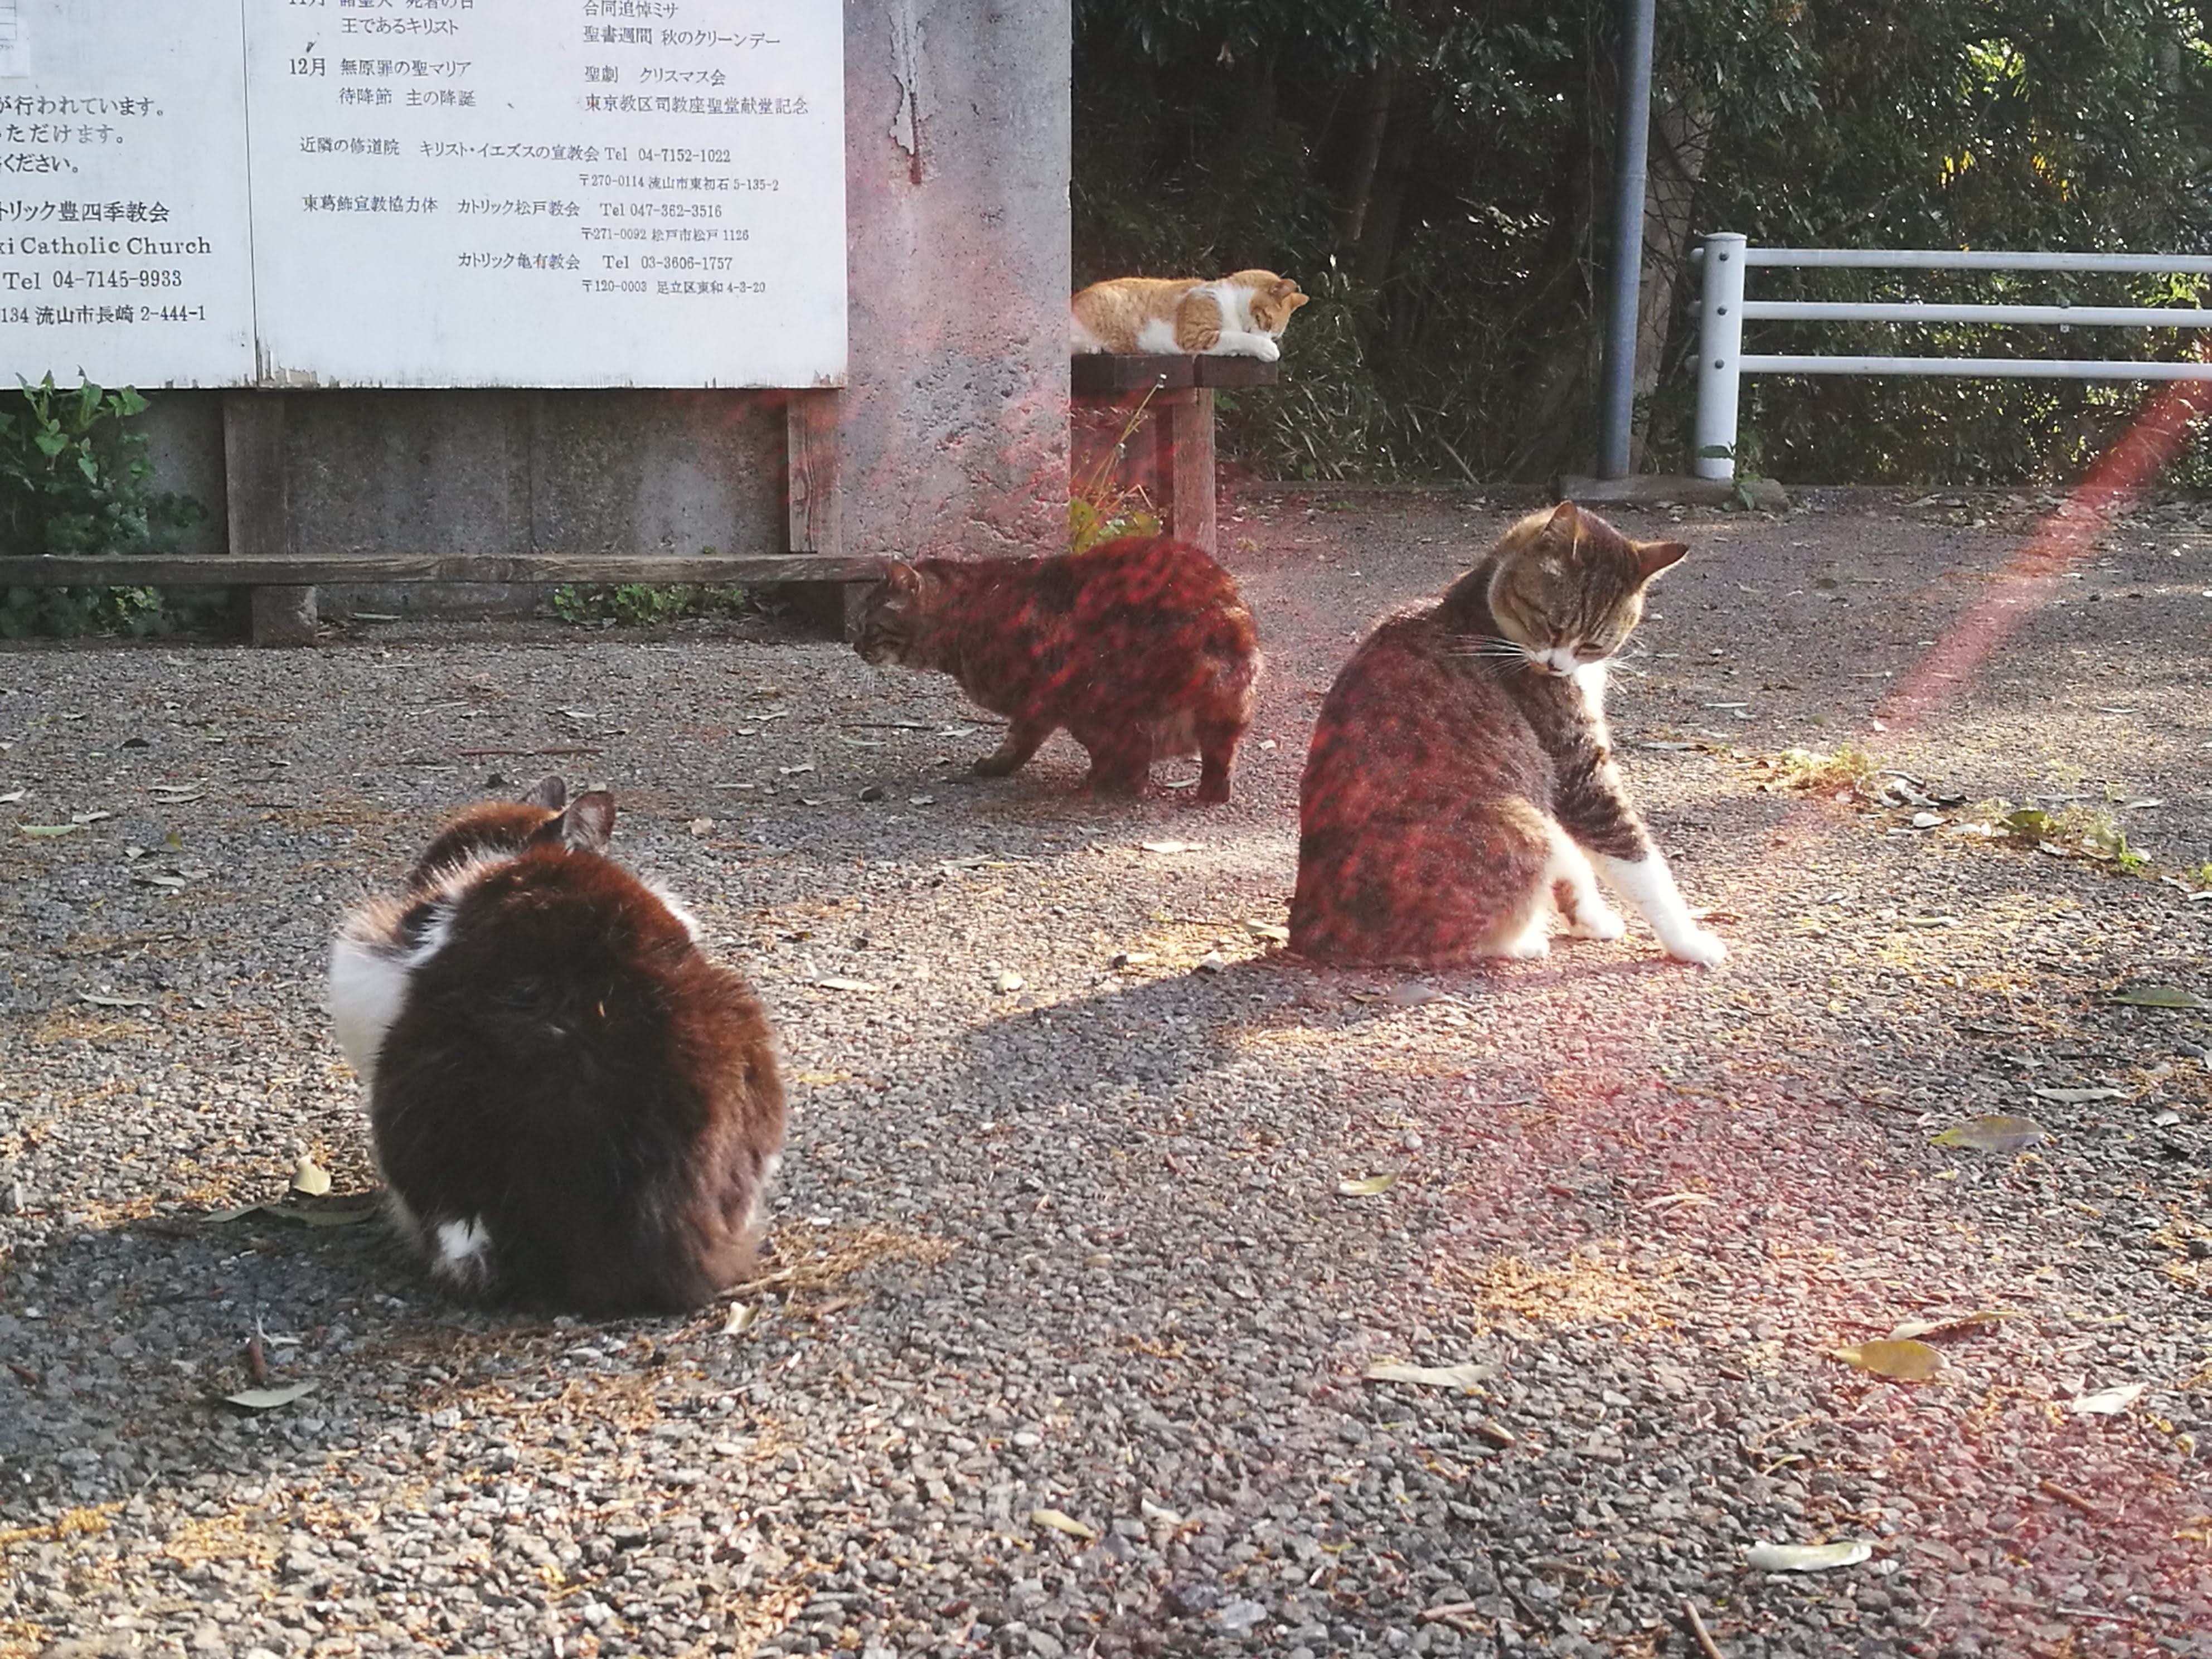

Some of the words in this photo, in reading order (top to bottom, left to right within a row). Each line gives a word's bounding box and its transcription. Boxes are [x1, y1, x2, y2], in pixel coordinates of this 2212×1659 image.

[583, 0, 678, 19] 合同追悼ミサ
[342, 17, 458, 35] 王であるキリスト
[584, 25, 652, 45] 聖書週間
[662, 30, 780, 48] 秋のクリーンデー
[290, 58, 325, 76] 12月
[340, 58, 471, 77] 無原罪の聖マリア
[585, 65, 618, 83] 聖劇
[641, 67, 725, 86] クリスマス会
[339, 88, 392, 105] 待降節
[406, 89, 476, 106] 主の降誕
[585, 94, 808, 114] 東京教区司教座聖堂献堂記念
[0, 124, 123, 144] ただけます。
[300, 136, 399, 156] 近隣の修道院
[420, 141, 599, 162] キリスト・イエズスの宣教会
[604, 147, 627, 161] Tel
[638, 148, 730, 162] 04-7152-1022
[0, 153, 78, 173] ください。
[579, 174, 644, 187] 〒270-0114
[648, 176, 729, 190] 流山市東初石
[734, 178, 778, 191] 5-135-2
[302, 194, 438, 213] 東葛飾宣教協力体
[458, 199, 580, 217] カトリック松戸教会
[600, 203, 624, 216] Tel
[630, 203, 721, 217] 047-362-3516
[581, 227, 647, 240] 〒271-0092
[652, 229, 718, 241] 松戸市松戸
[724, 229, 749, 241] 1126
[21, 236, 120, 254] Catholic
[127, 236, 211, 255] Church
[458, 253, 580, 270] カトリック亀有教会
[603, 255, 629, 269] Tel
[642, 256, 733, 270] 03-3606-1757
[3, 272, 41, 290] Tel
[53, 270, 182, 288] 04-7145-9933
[582, 280, 647, 292] 〒120-0003
[657, 280, 723, 294] 足立区東和
[727, 282, 765, 293] 4-3-20
[35, 304, 134, 326] 流山市長崎
[140, 305, 205, 321] 2-444-1
